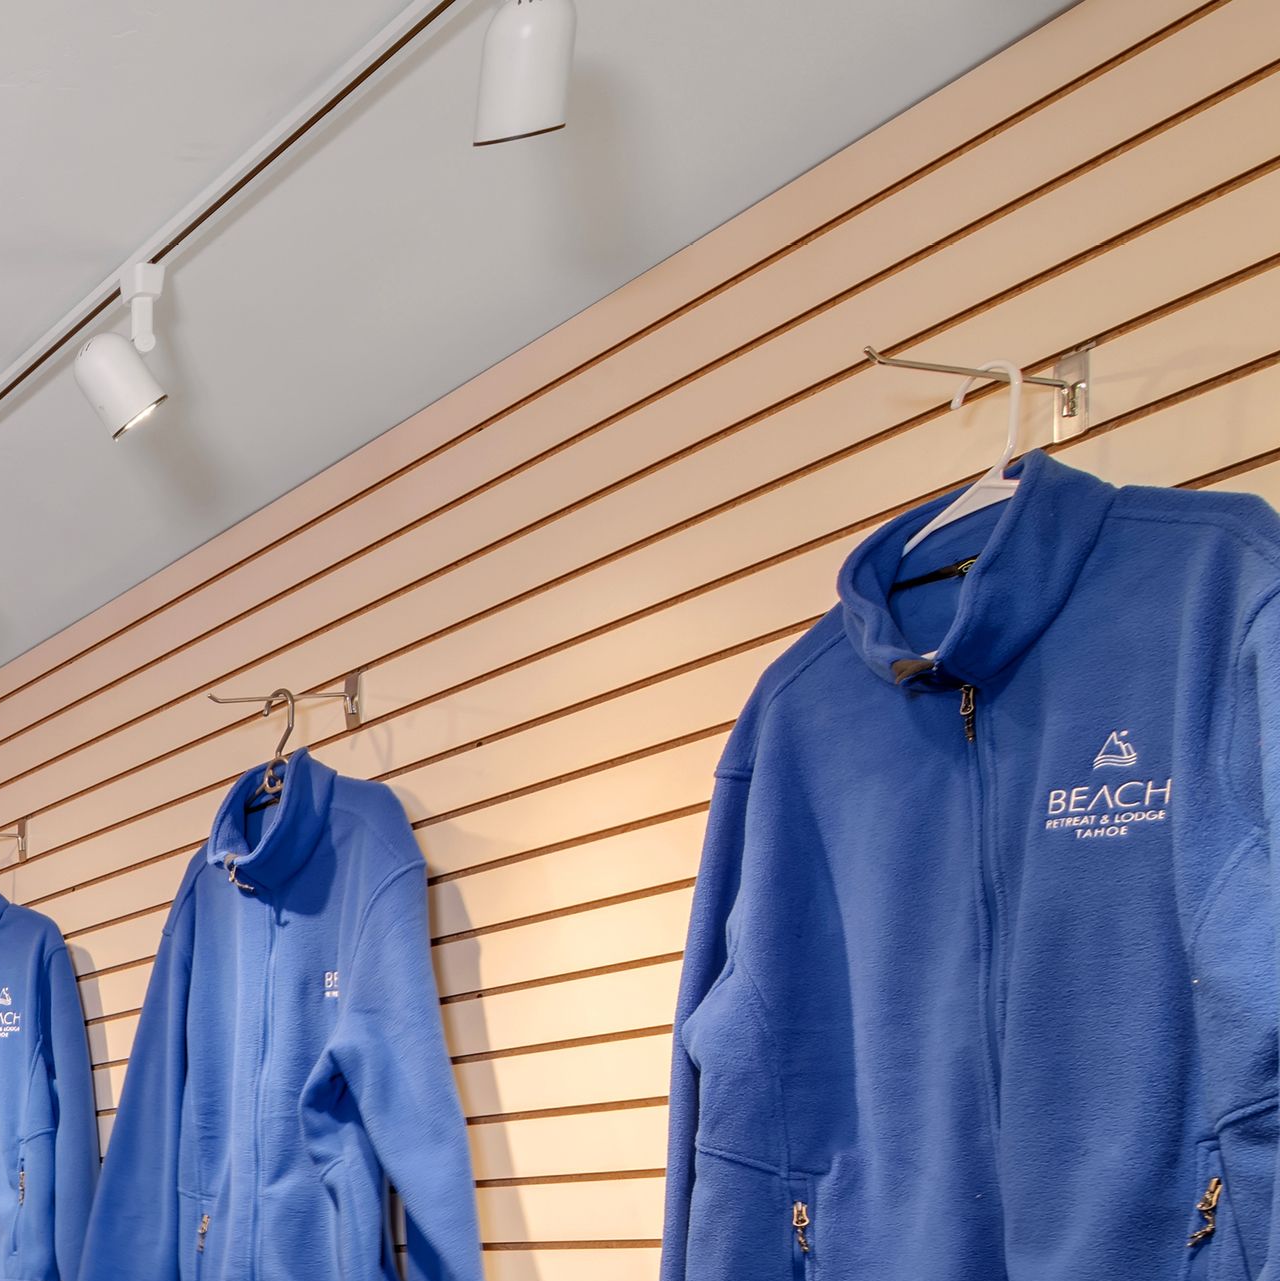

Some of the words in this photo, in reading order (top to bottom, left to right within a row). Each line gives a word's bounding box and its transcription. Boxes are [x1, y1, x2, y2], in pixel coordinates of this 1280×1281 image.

[1047, 778, 1172, 815] BEACH
[1046, 815, 1095, 830] RETREAT
[1100, 815, 1109, 824] &
[1115, 809, 1166, 823] LODGE
[1076, 826, 1128, 839] TAHOE
